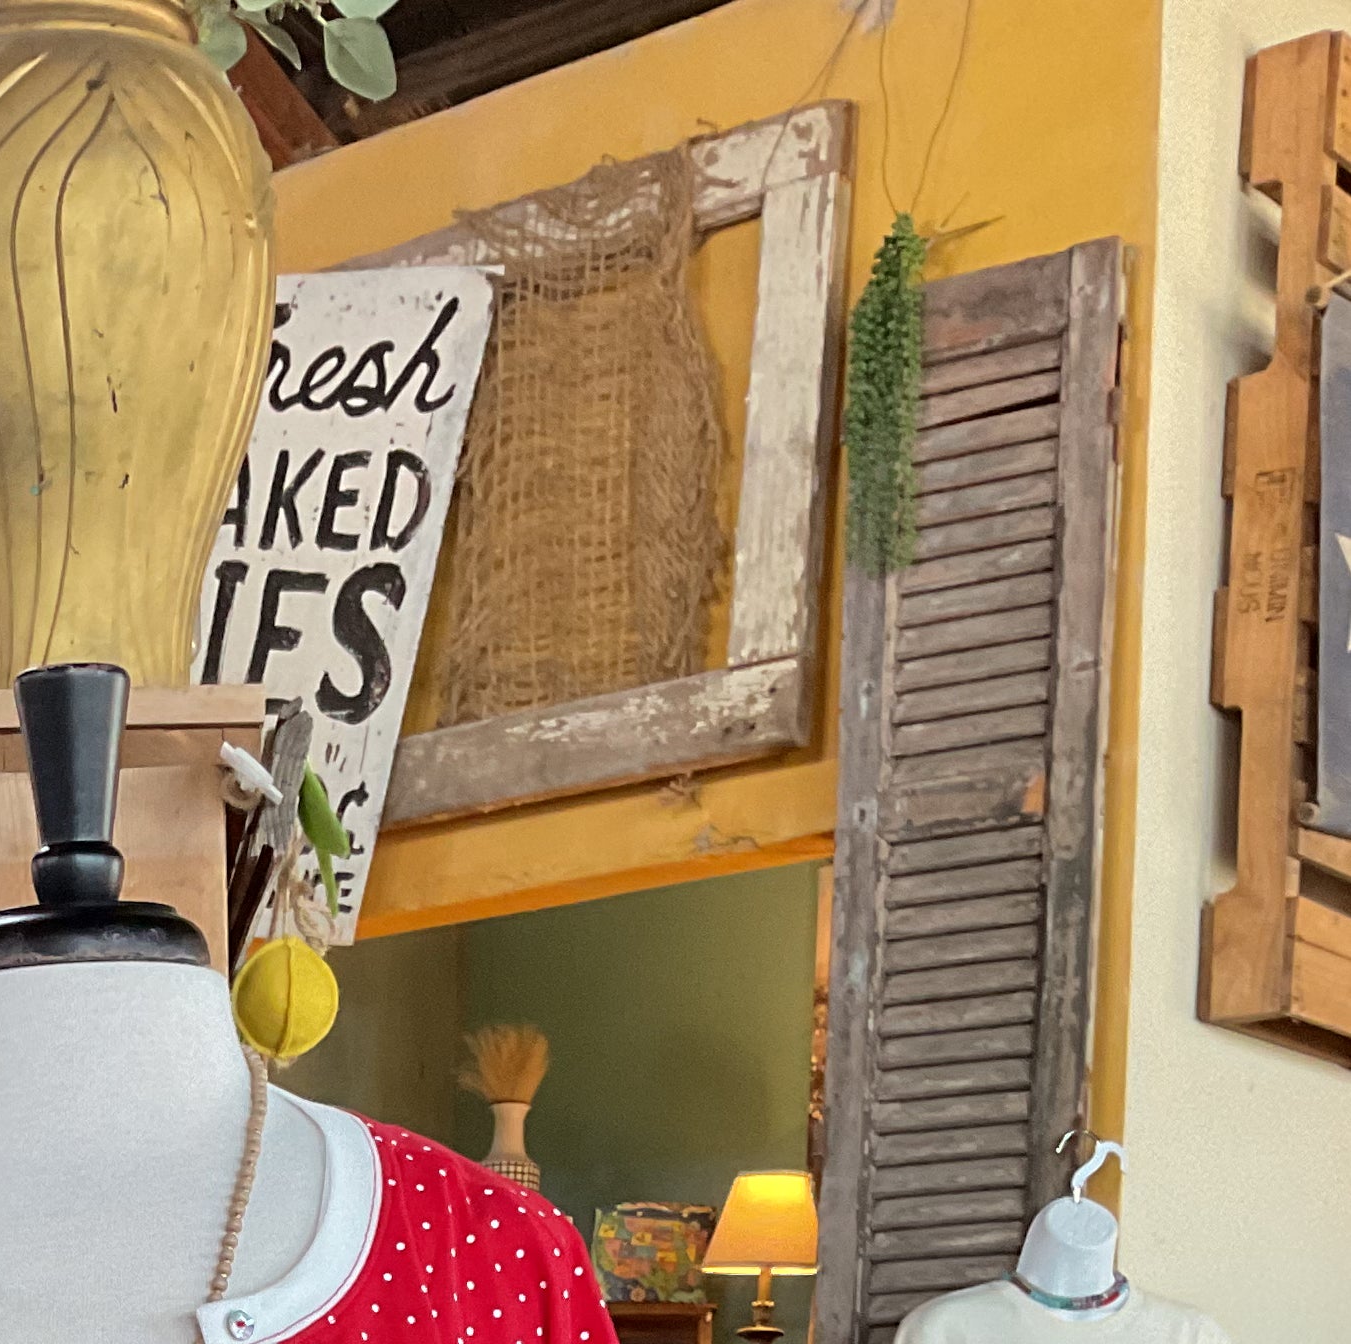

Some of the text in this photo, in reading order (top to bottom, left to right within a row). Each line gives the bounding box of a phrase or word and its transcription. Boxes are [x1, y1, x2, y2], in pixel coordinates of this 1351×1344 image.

[266, 297, 459, 417] resh
[222, 447, 431, 552] AKED
[201, 559, 406, 726] IES
